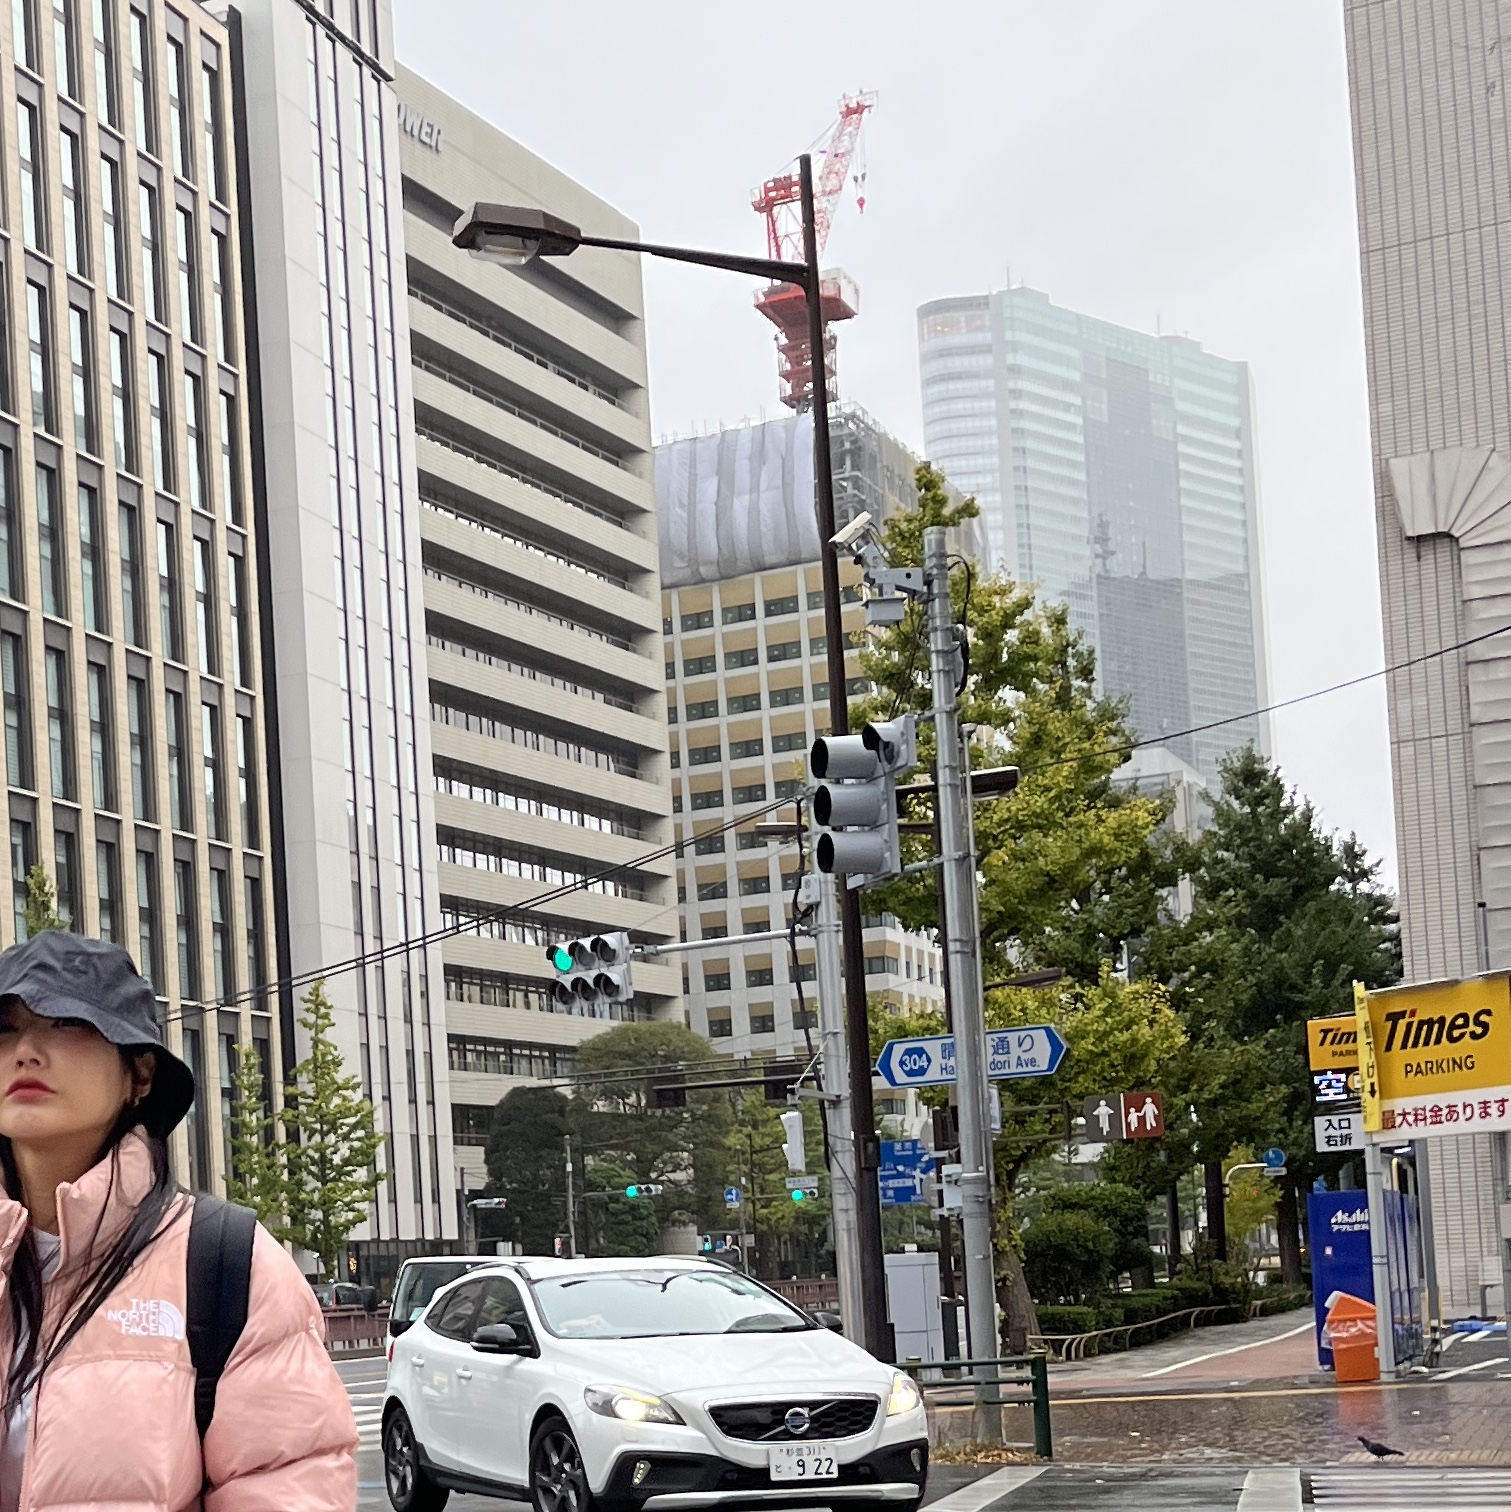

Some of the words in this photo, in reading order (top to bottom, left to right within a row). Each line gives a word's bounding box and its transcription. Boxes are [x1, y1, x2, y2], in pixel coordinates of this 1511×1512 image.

[1319, 1027, 1357, 1047] Tim
[1384, 1008, 1493, 1054] Times
[941, 1034, 1034, 1060] 晴通り
[1332, 1049, 1358, 1057] PARK
[902, 1054, 929, 1071] 304
[1016, 1054, 1040, 1069] Ave.
[1405, 1054, 1476, 1078] PARKING
[1382, 1097, 1510, 1130] 最大料金あります
[1324, 1118, 1351, 1131] 入口
[1325, 1134, 1353, 1147] 右折
[130, 1299, 159, 1311] THE
[107, 1309, 159, 1323] NORTH
[121, 1321, 159, 1336] FACE
